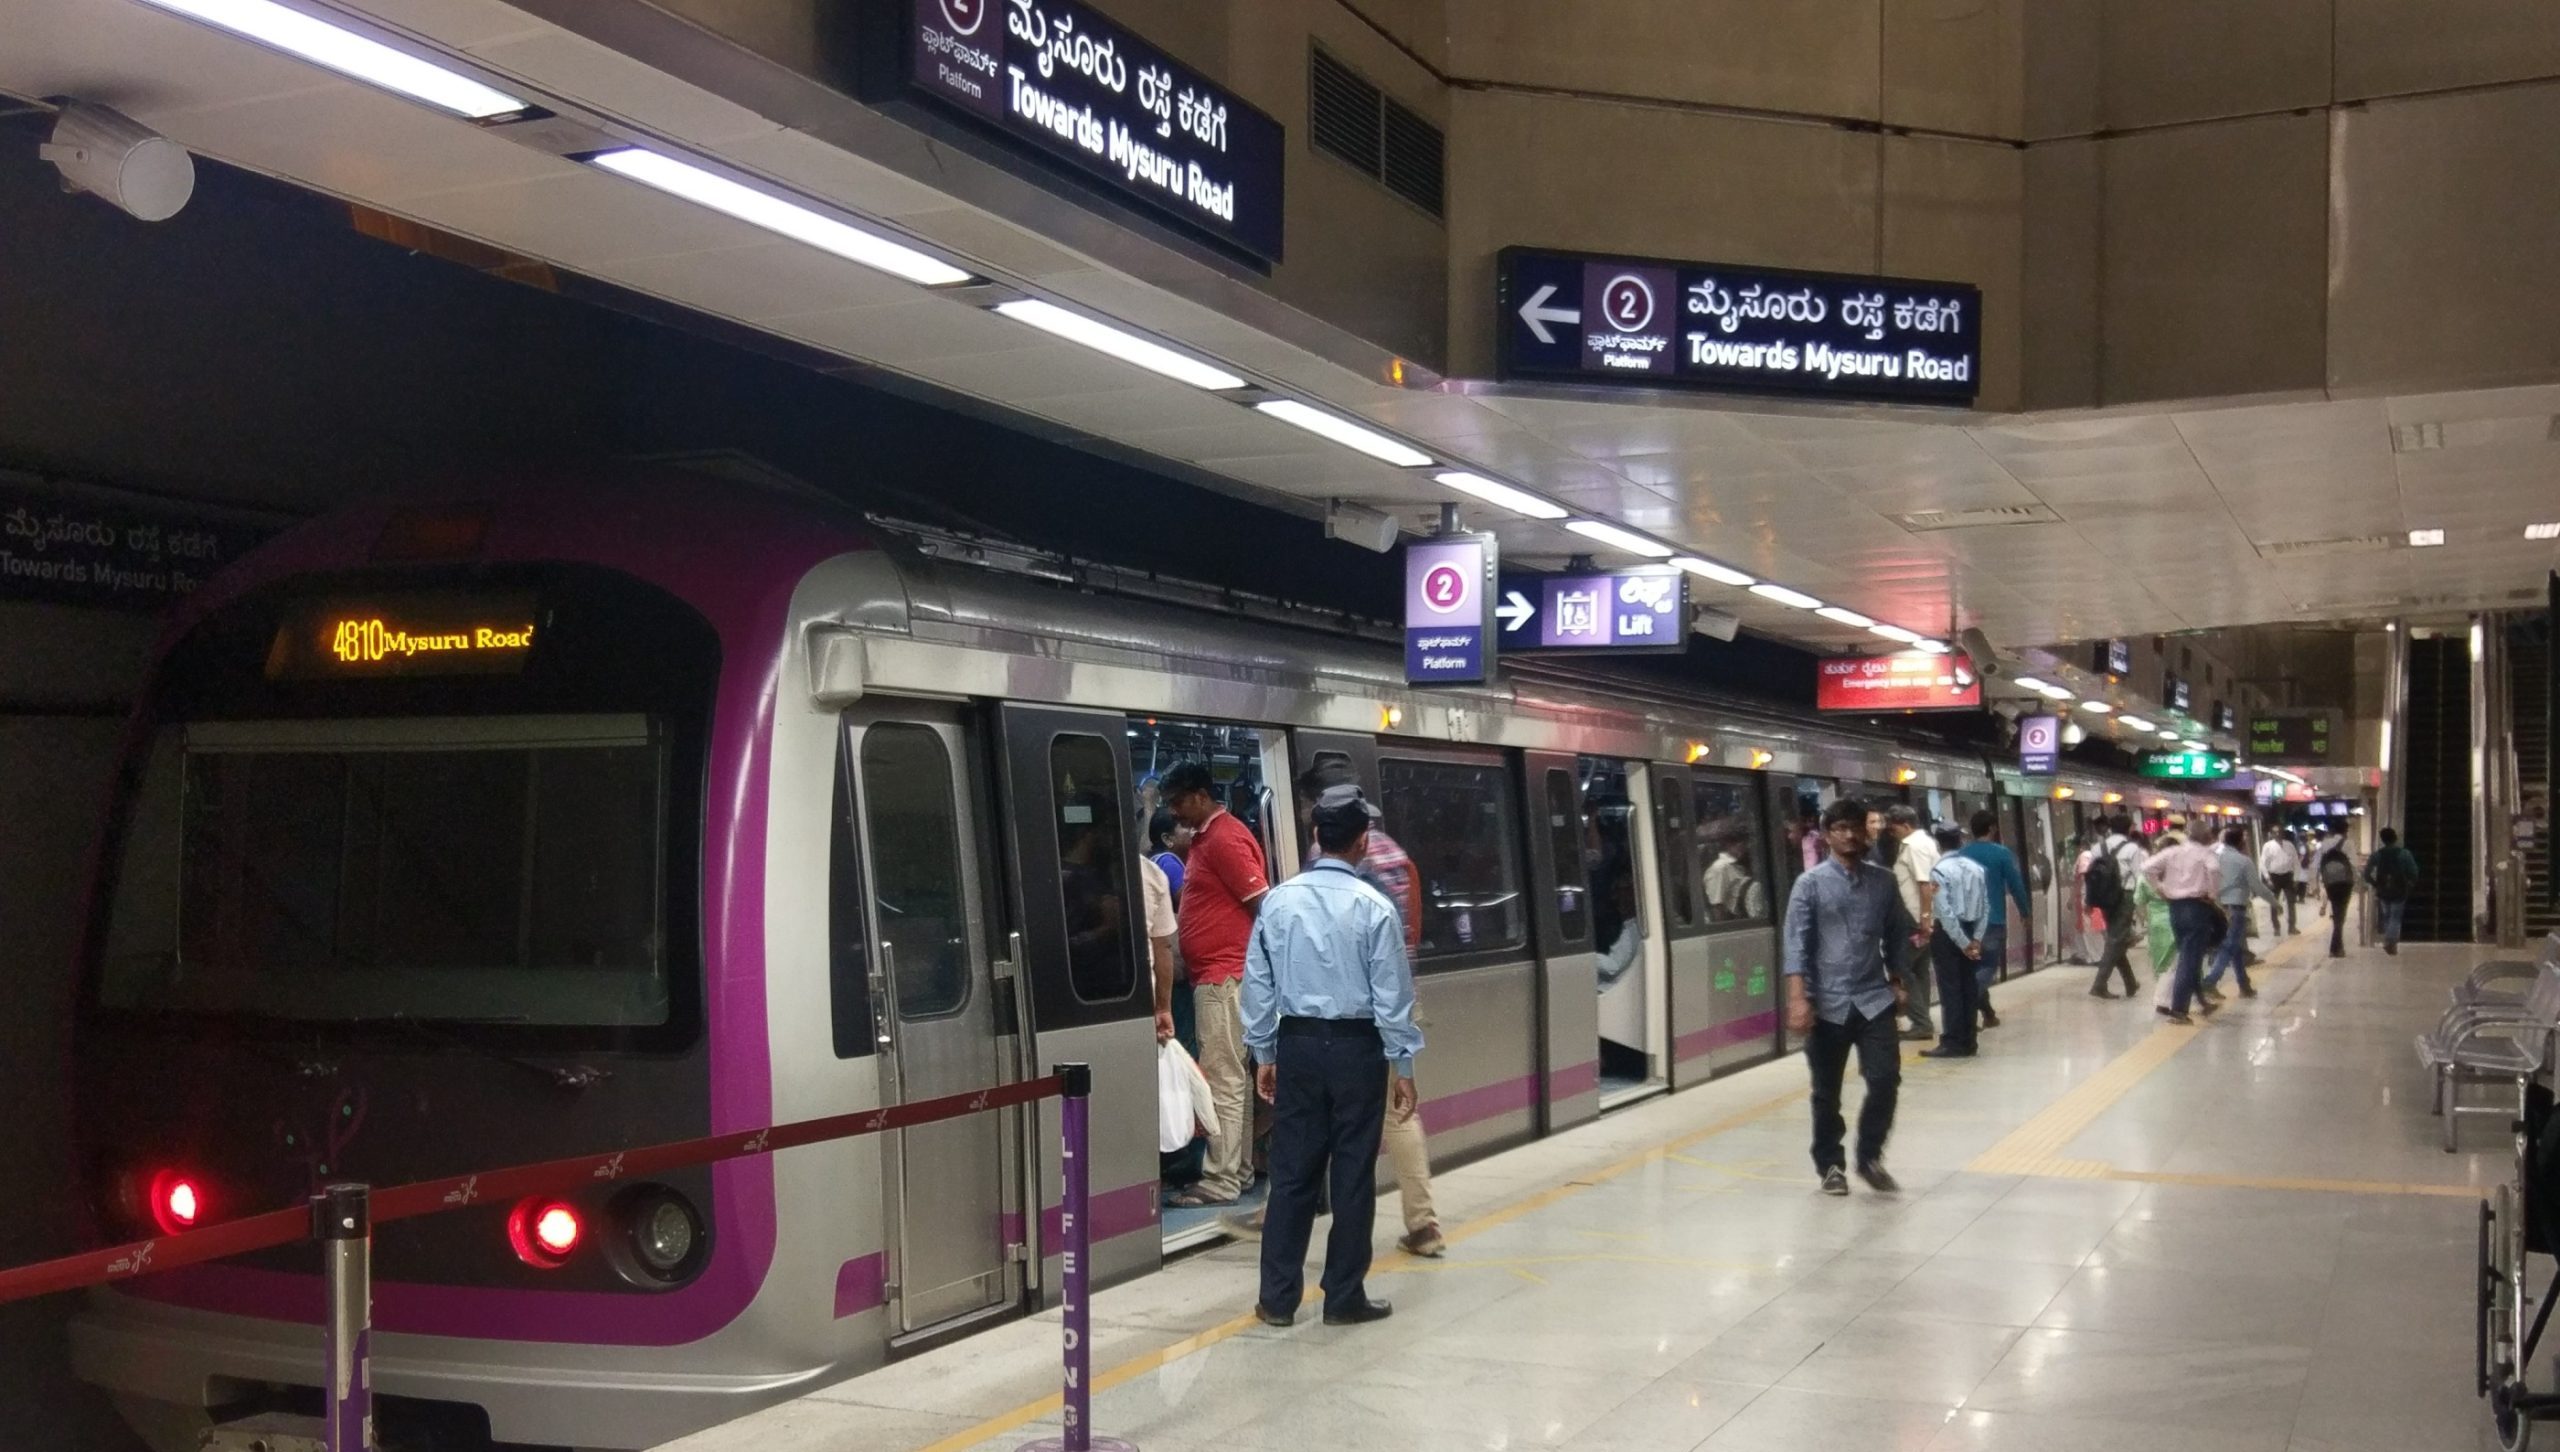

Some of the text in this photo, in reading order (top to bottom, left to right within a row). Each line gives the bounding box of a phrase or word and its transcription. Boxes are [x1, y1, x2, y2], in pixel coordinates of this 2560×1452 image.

[939, 63, 982, 99] Platform
[1138, 64, 1172, 138] ರಸ್ತೆ
[1179, 85, 1228, 152] ಕಡೆಗೆ
[1008, 66, 1234, 221] Towards Mysuru Road
[1620, 291, 1637, 319] 2
[1688, 279, 1961, 341] ಮೈಸೂರು ರಸ್ತೆ ಕಡೆಗೆ
[1603, 354, 1651, 370] Platform
[1687, 333, 1969, 382] Towards Mysuru Road
[0, 551, 87, 582] Towards
[94, 562, 166, 592] Mysuru
[1436, 573, 1454, 601] 2
[333, 619, 384, 662] 4810
[384, 631, 469, 656] Mysuru
[1619, 615, 1654, 636] Lift
[1423, 656, 1467, 670] Platform
